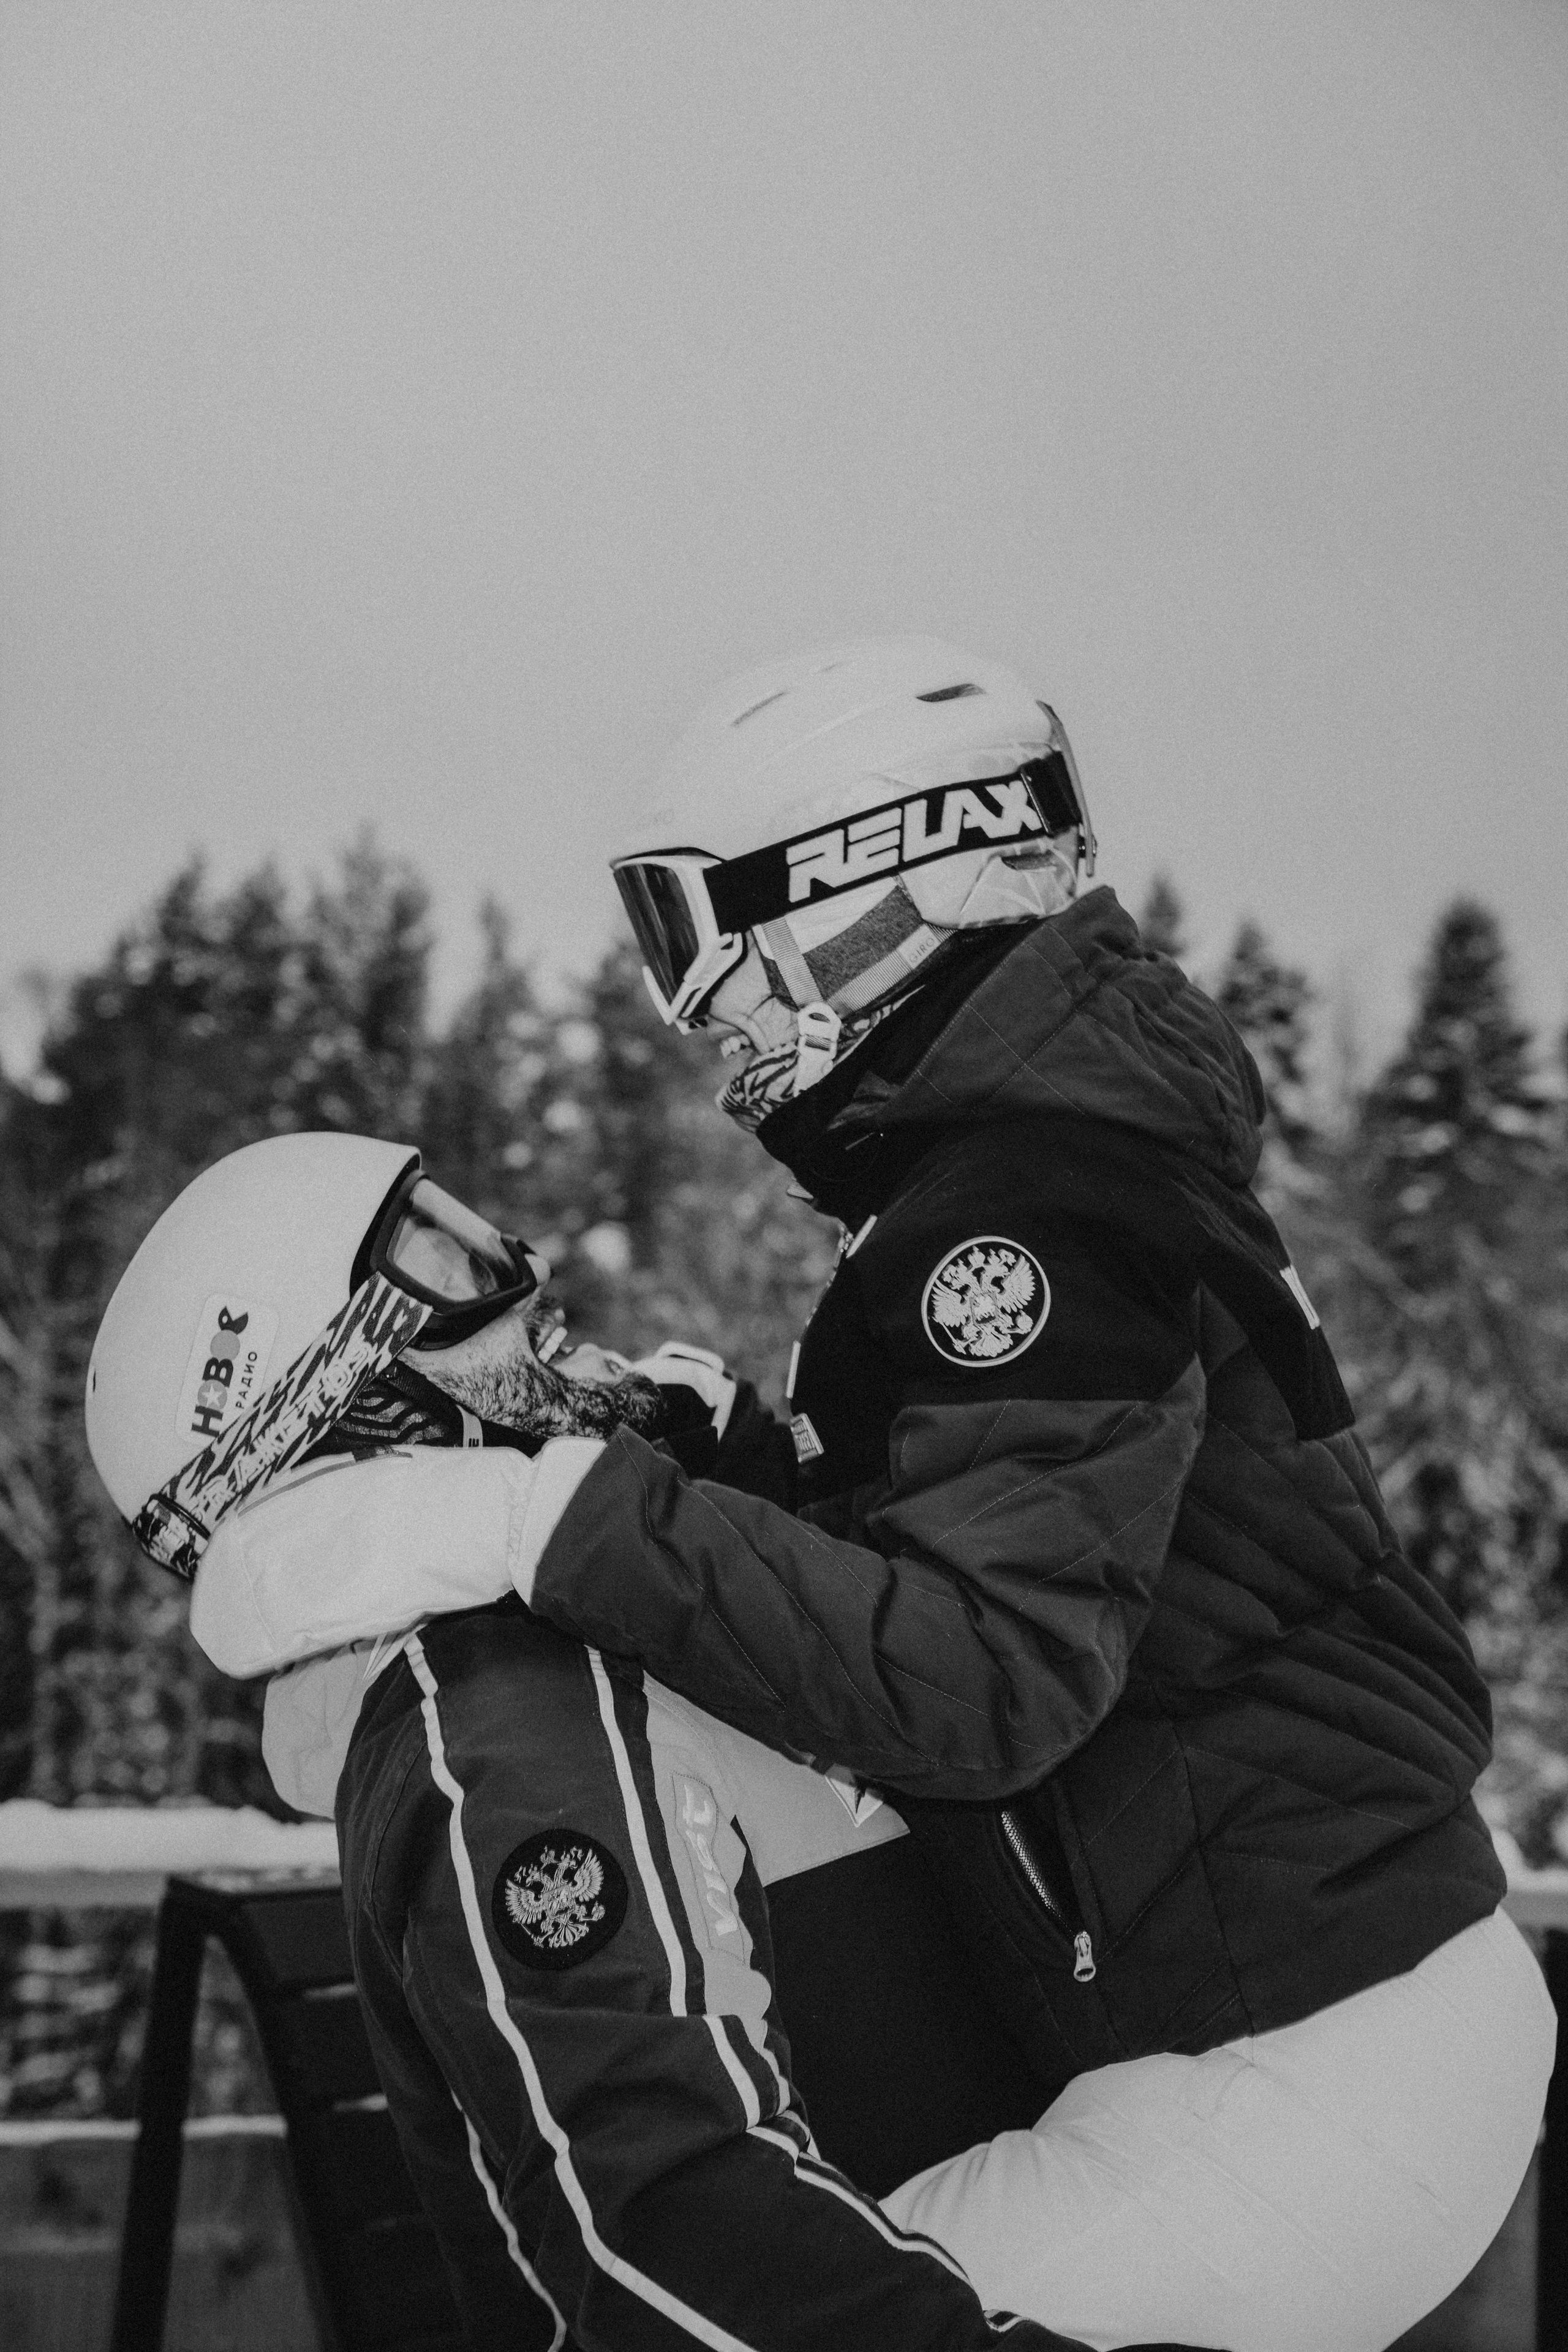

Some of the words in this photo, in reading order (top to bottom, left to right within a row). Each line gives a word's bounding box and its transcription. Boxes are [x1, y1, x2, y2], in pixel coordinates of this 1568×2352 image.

[786, 780, 1042, 903] RELAX
[909, 937, 934, 963] GIRO
[235, 1351, 258, 1409] РАДИО
